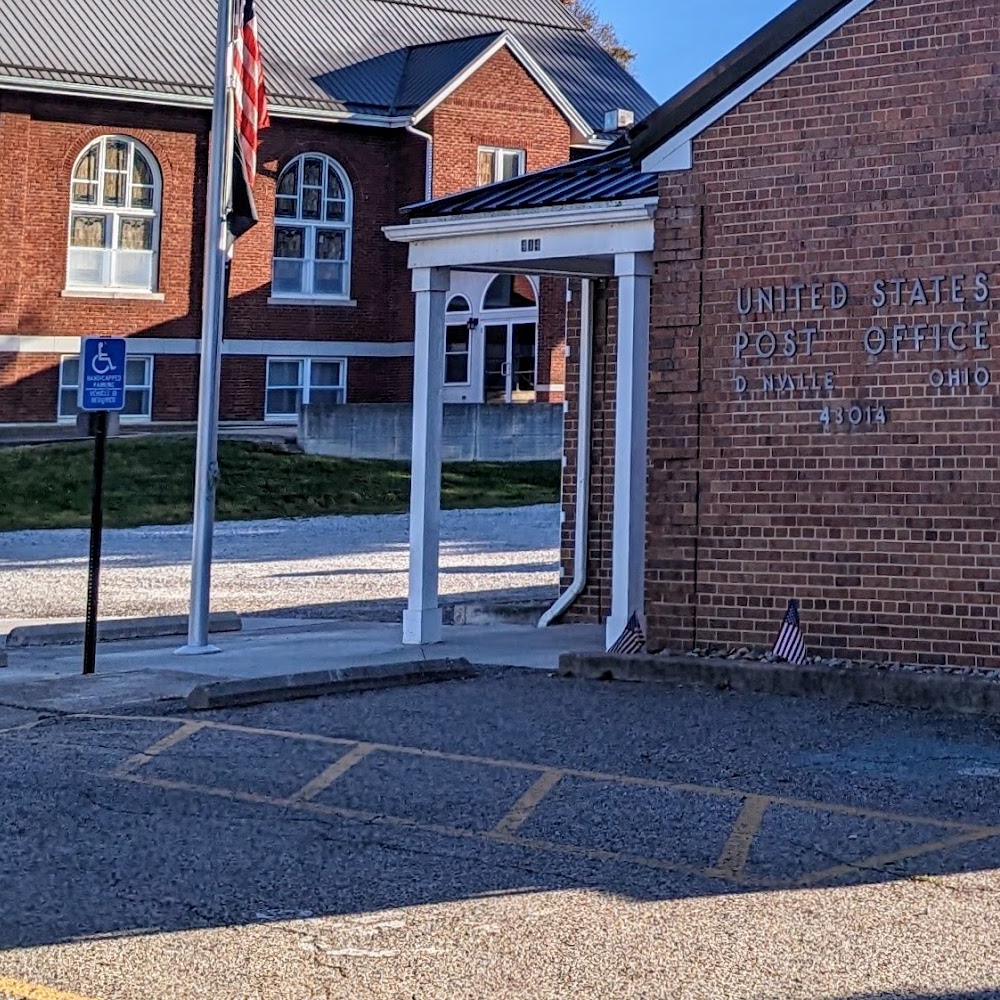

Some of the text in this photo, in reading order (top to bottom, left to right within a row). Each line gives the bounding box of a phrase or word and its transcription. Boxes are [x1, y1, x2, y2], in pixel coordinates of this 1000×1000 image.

[737, 271, 989, 315] UNITED STATES
[733, 320, 990, 360] POST OFFICE
[929, 367, 990, 388] OHIO
[819, 405, 887, 425] 43014
